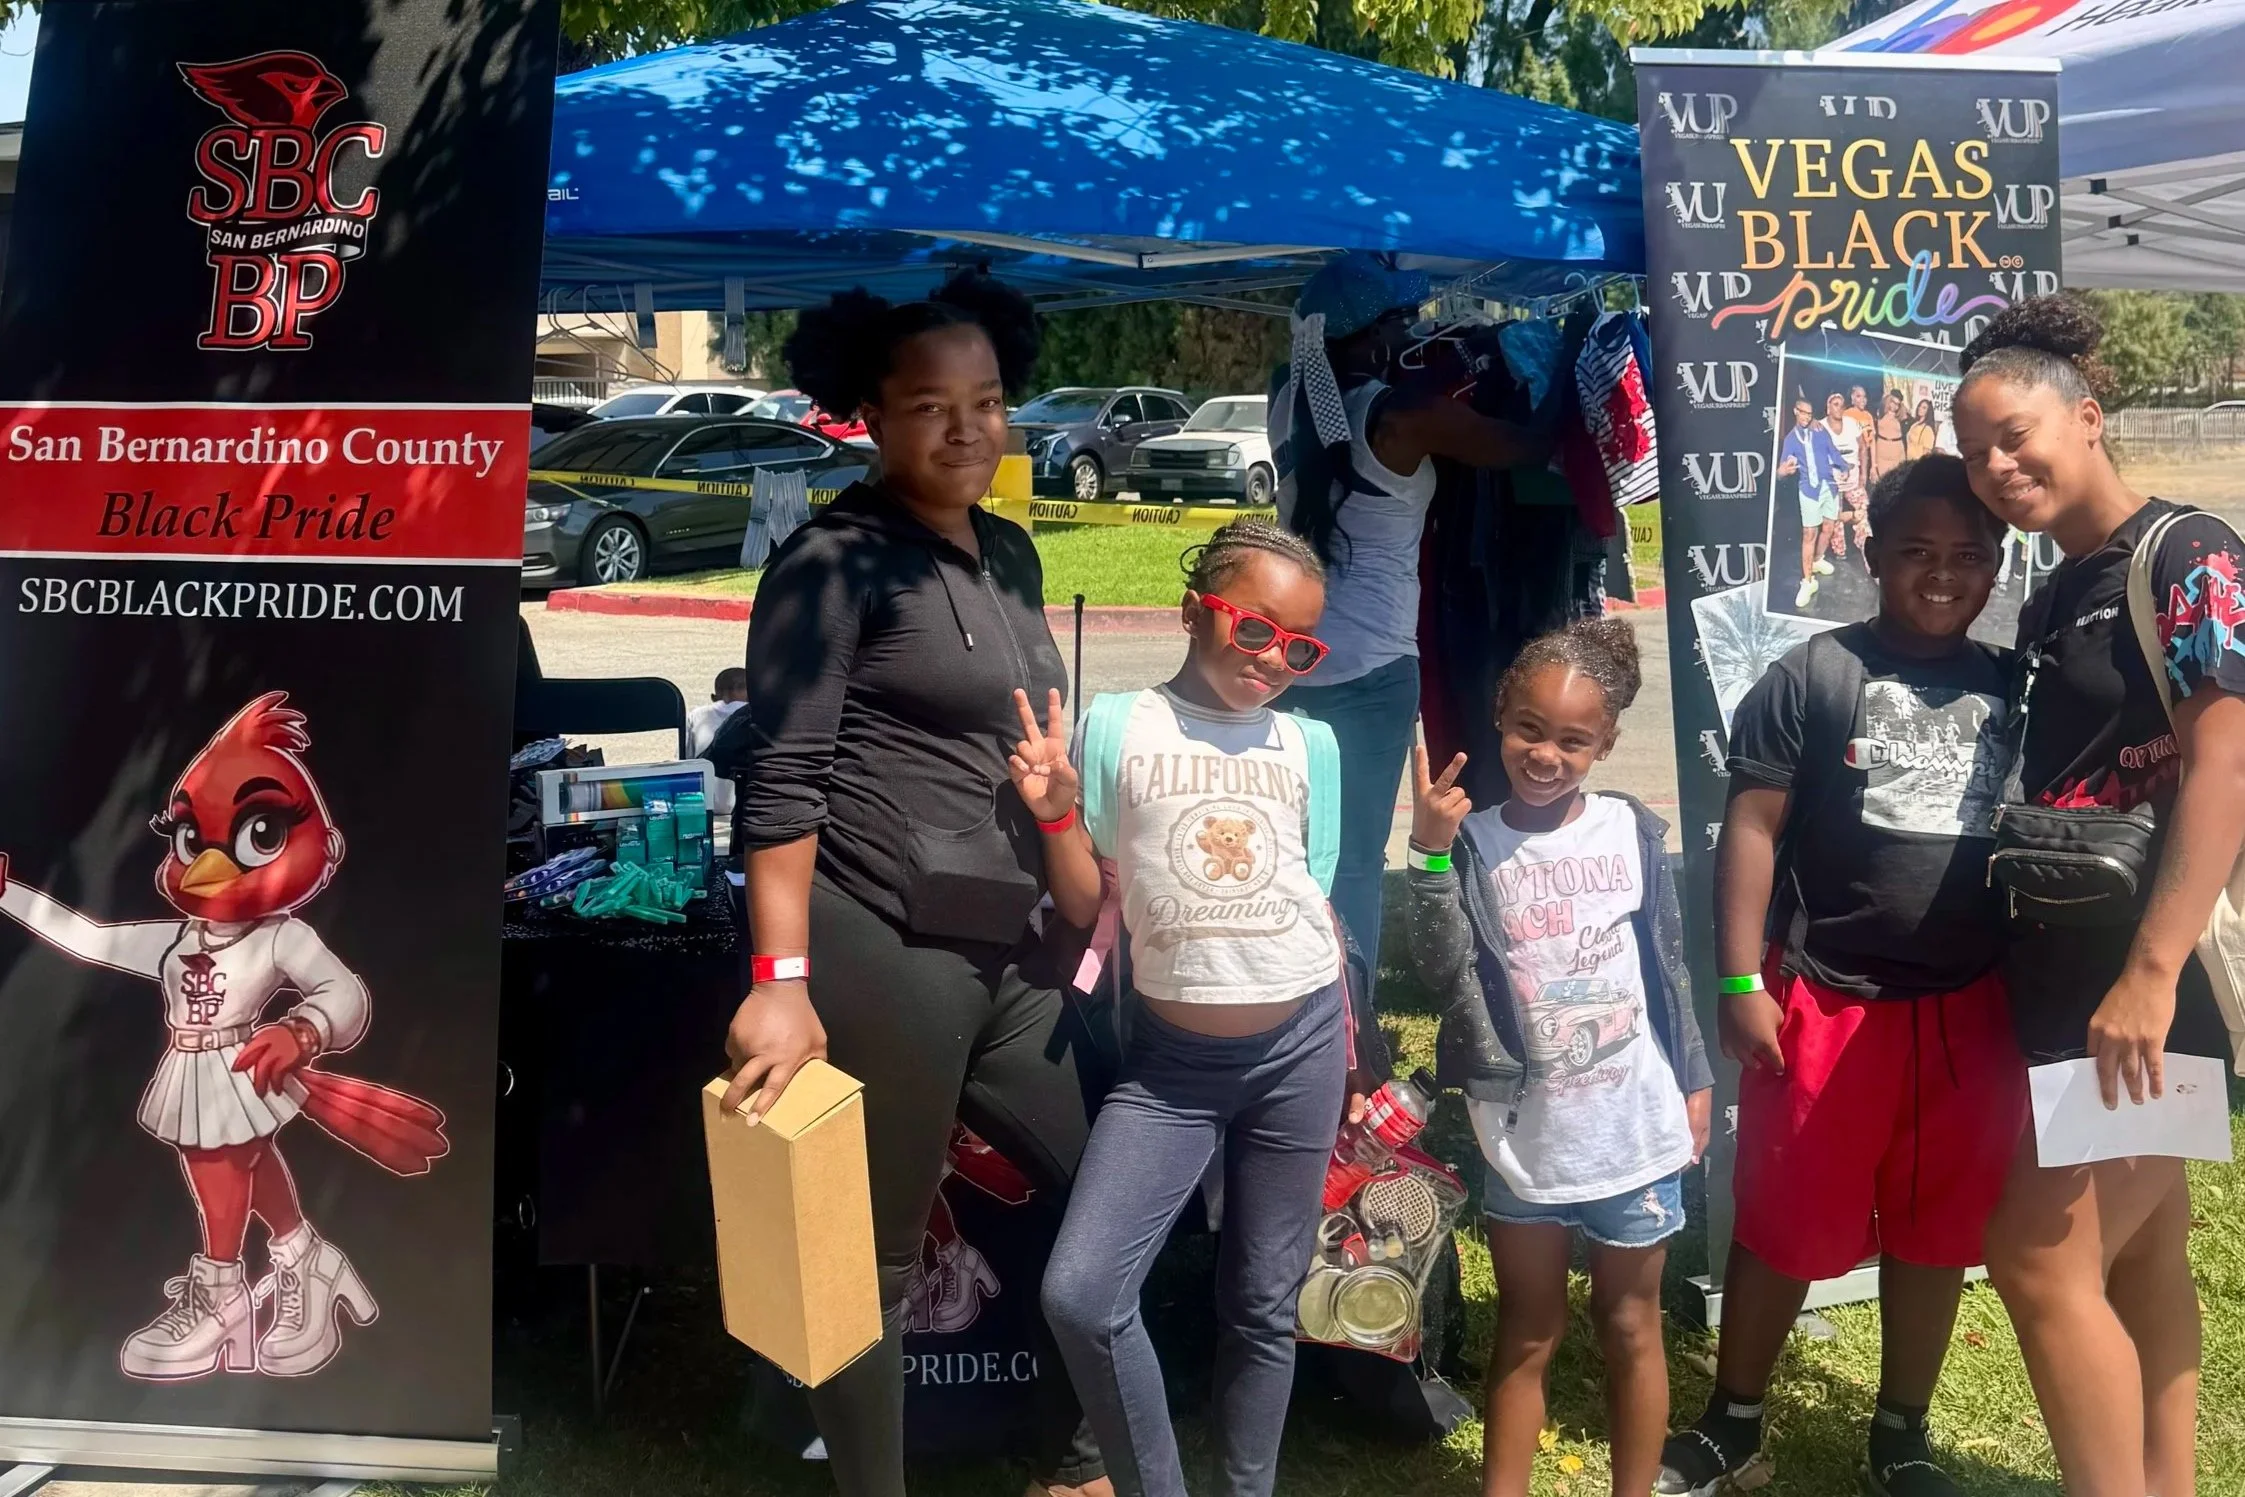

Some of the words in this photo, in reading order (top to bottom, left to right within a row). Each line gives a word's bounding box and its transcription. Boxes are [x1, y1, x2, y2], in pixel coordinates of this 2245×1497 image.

[187, 121, 386, 223] SBC
[1729, 138, 1993, 200] VEGAS
[210, 229, 247, 249] SAN
[250, 218, 365, 249] BERNARDINO
[1737, 209, 1997, 270] BLACK
[197, 250, 346, 351] BP
[1711, 249, 2010, 339] pride
[1677, 362, 1758, 403] VUP
[8, 425, 83, 462] San
[97, 426, 329, 465] Bernardino
[342, 427, 504, 478] County
[1682, 452, 1765, 494] VUP
[97, 490, 243, 538] Black
[253, 492, 396, 541] Pride
[18, 578, 464, 622] SBCBLACKPRIDE.COM
[2075, 606, 2119, 627] REACTION
[1490, 854, 1632, 906] YTONA
[1148, 895, 1299, 927] Dreaming
[1504, 899, 1575, 942] ACH
[1567, 934, 1625, 976] Legend
[181, 970, 227, 995] SBC
[186, 1002, 220, 1025] BP
[903, 1351, 1039, 1386] PRIDE.C
